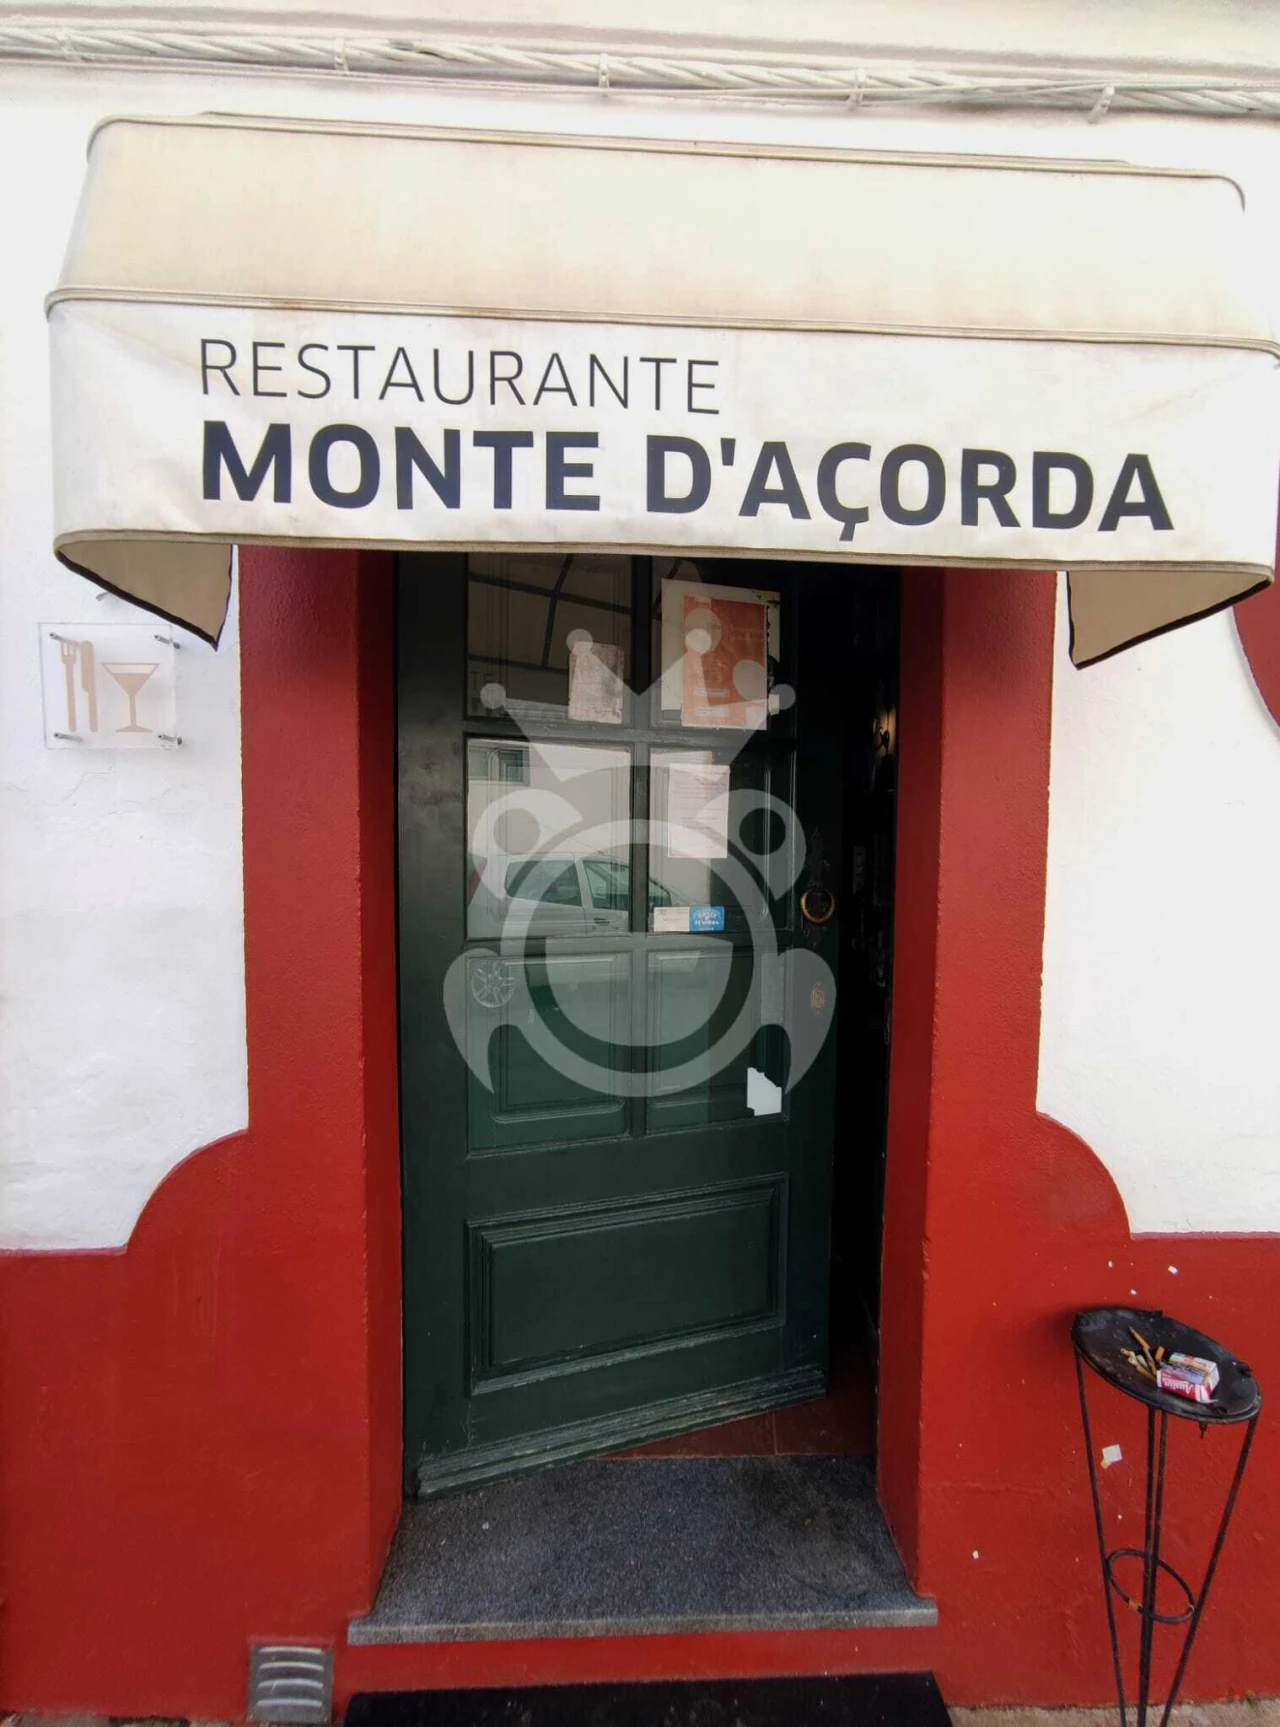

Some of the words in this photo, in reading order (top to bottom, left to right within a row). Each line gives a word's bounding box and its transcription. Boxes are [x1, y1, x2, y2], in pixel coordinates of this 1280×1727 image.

[200, 338, 720, 415] RESTAURANTE
[202, 420, 601, 512] MONTE
[646, 434, 1175, 542] D'AÇORDA
